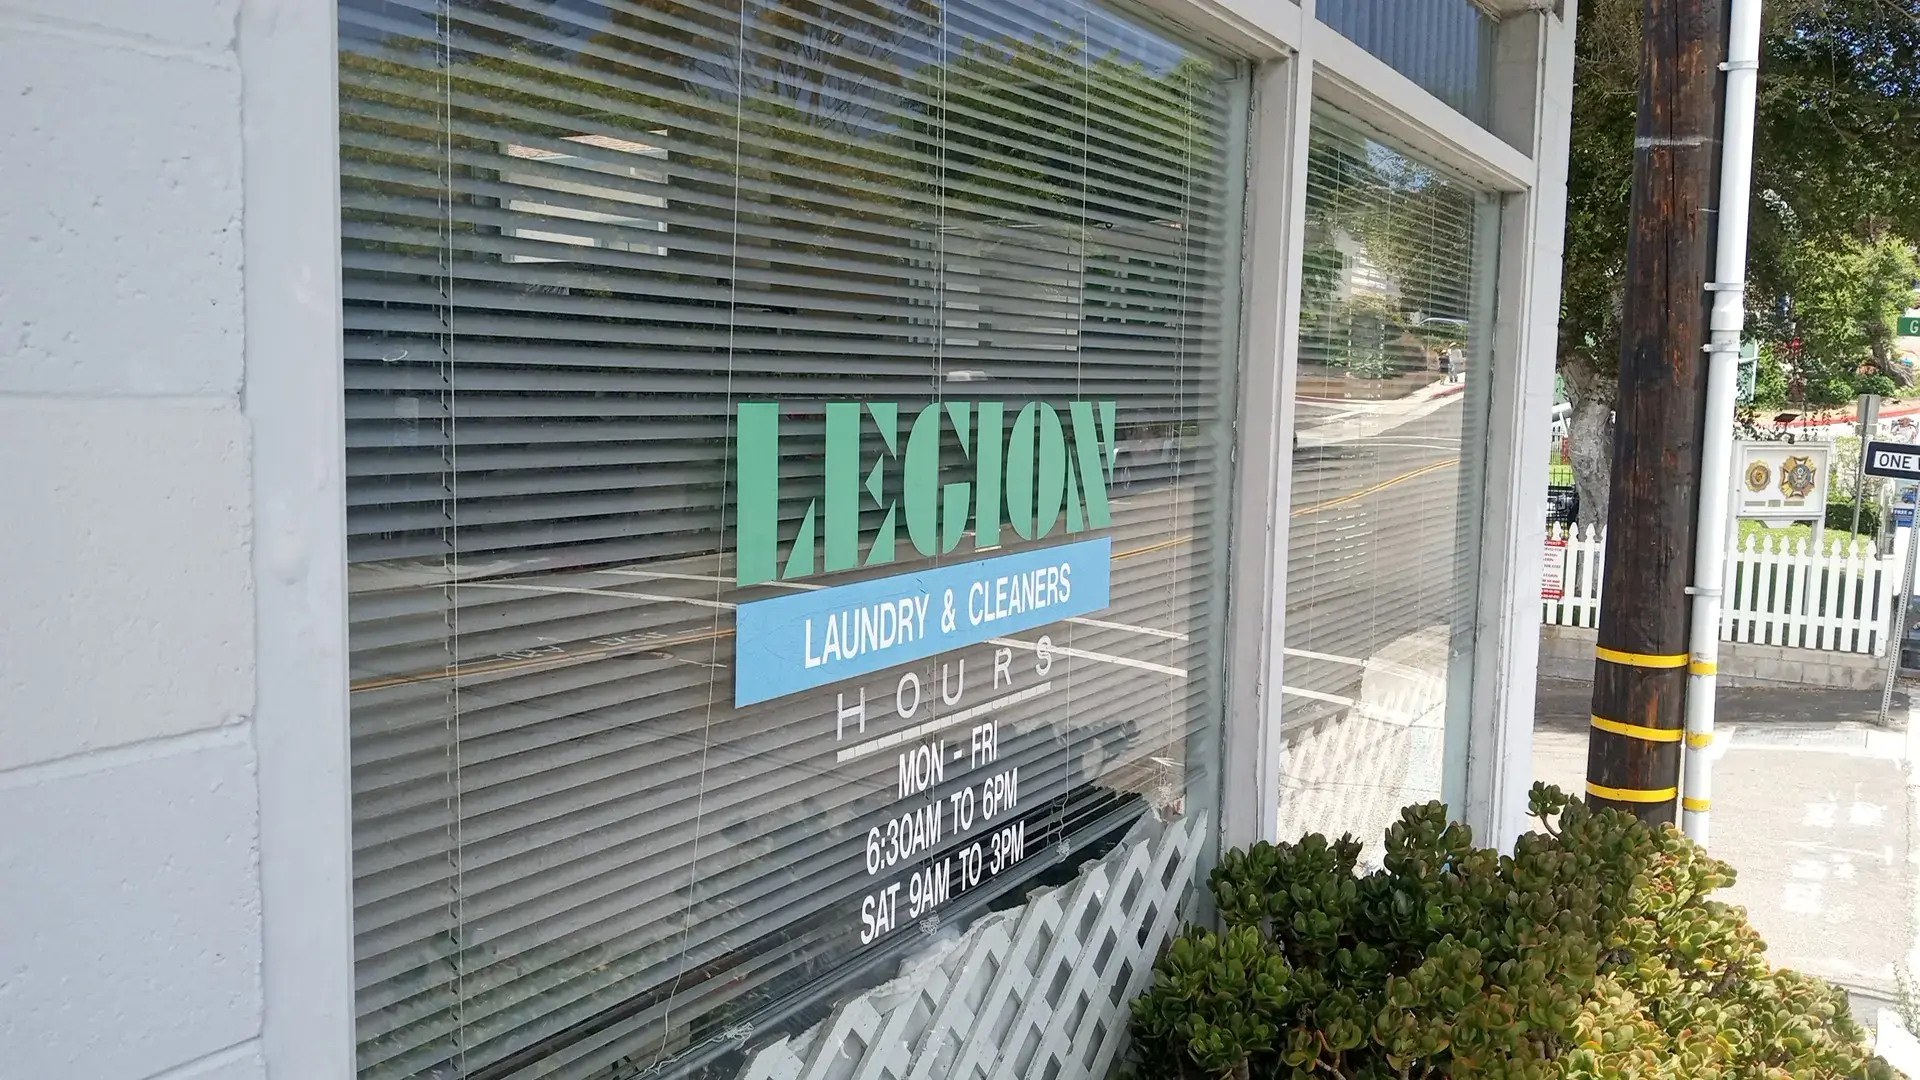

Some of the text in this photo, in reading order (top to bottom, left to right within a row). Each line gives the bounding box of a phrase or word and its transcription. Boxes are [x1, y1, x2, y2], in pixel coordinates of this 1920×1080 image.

[736, 401, 1117, 588] LEGION
[1880, 453, 1912, 470] ONE
[804, 562, 1071, 669] LAUNDRY & CLEANERS
[836, 635, 1052, 741] HOURS
[898, 719, 998, 799] MON - FRI
[866, 767, 1018, 876] 6:30AM TO 6PM
[860, 820, 1025, 945] SAT 9AM TO 3PM
